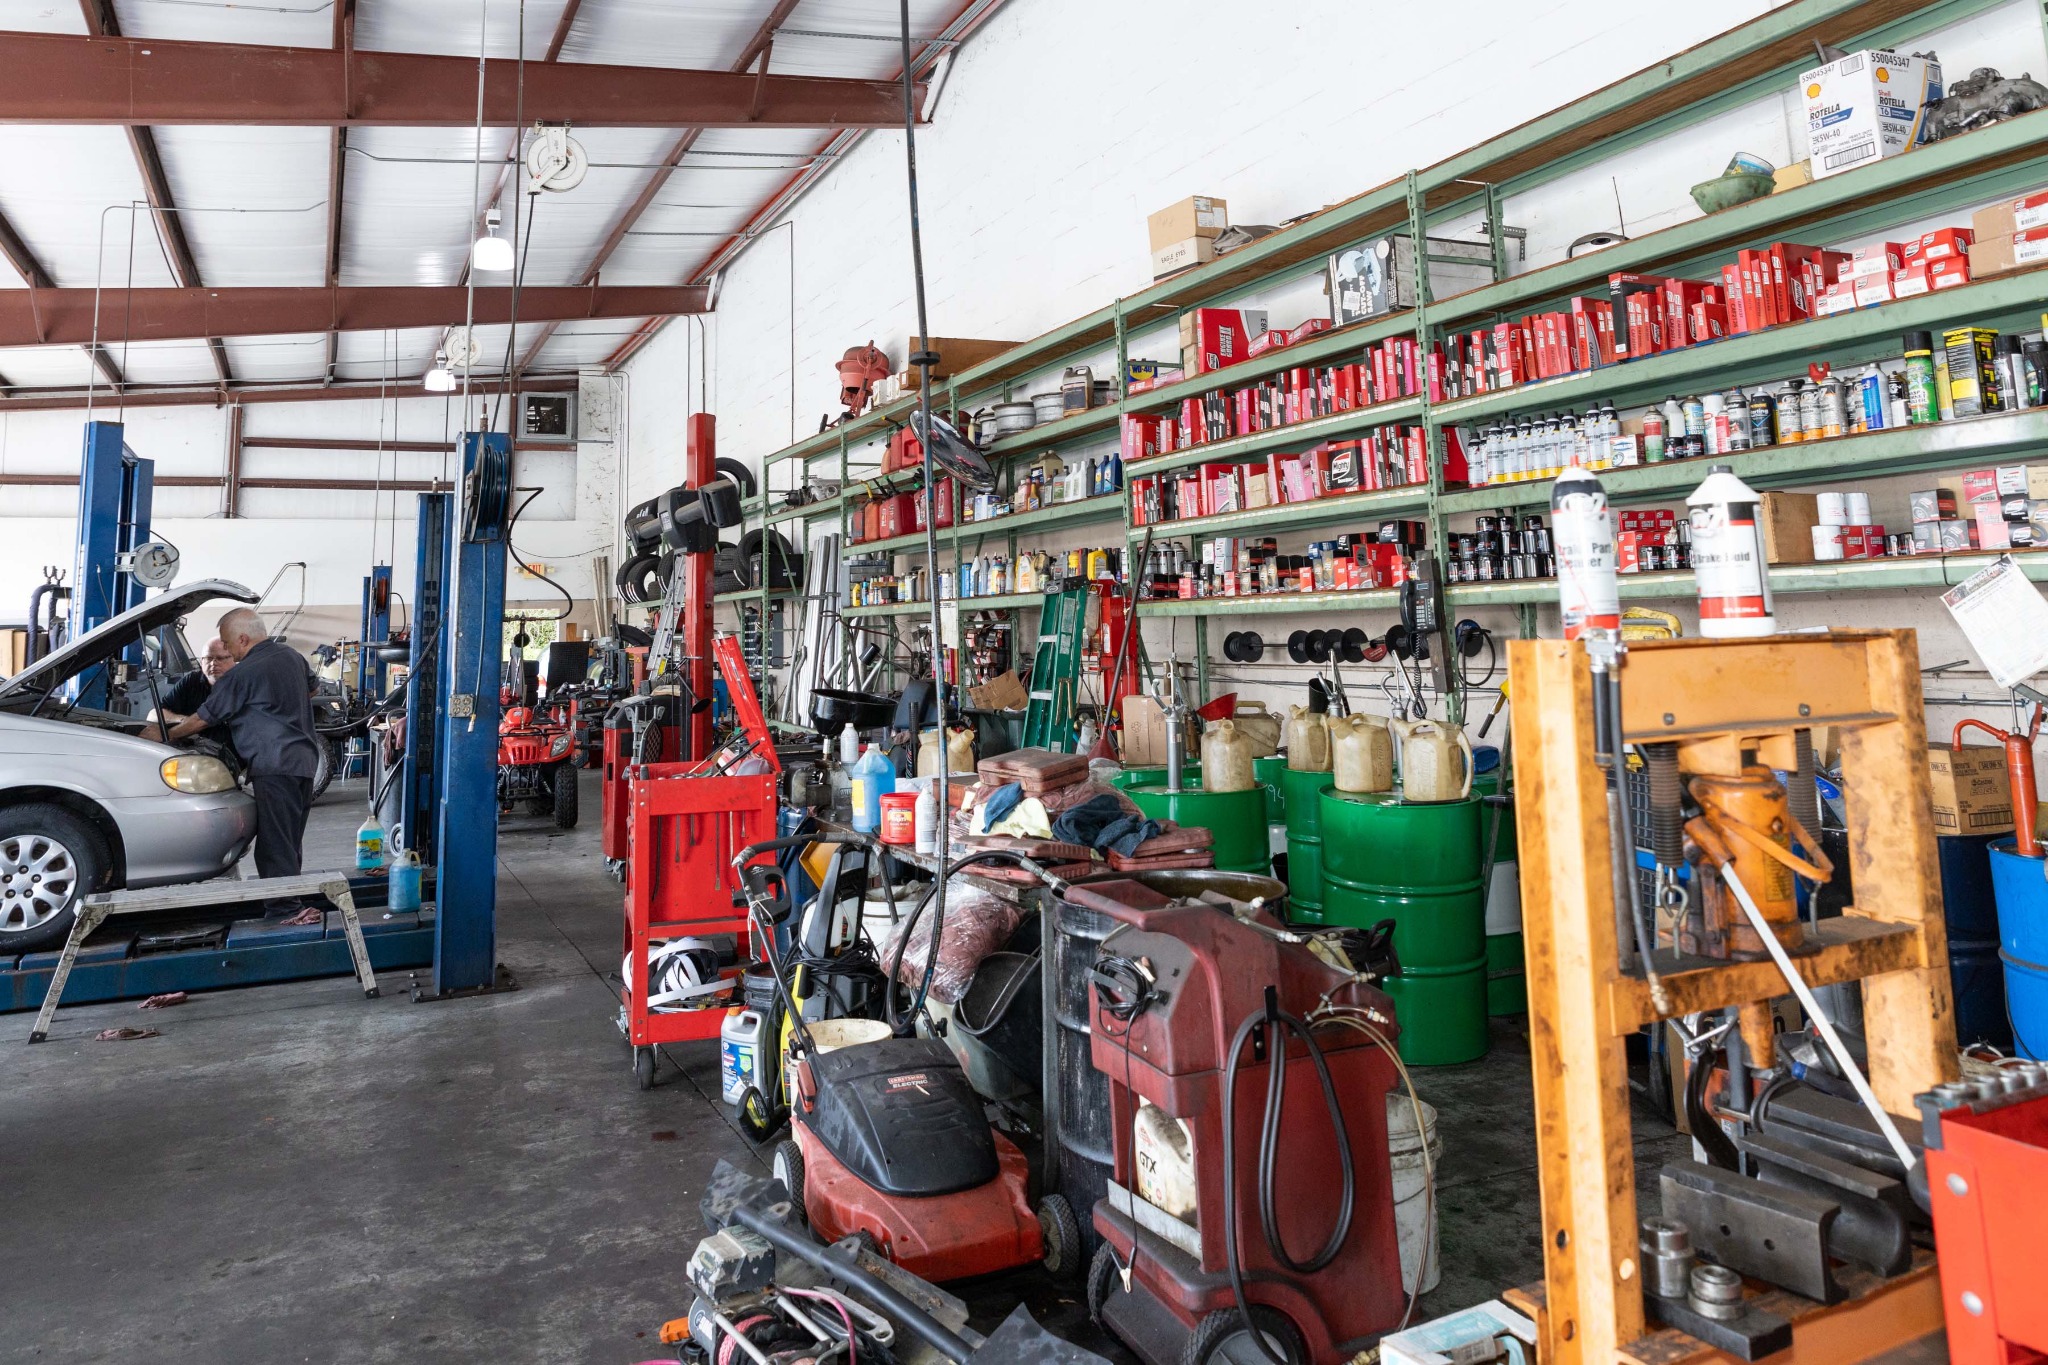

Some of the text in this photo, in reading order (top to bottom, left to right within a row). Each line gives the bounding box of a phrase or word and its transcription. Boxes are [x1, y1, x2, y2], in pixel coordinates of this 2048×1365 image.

[1871, 53, 1911, 69] 550045347
[1801, 64, 1835, 83] 550045347
[1880, 97, 1906, 108] ROTELLA
[1810, 103, 1841, 121] ROTELLA
[1880, 106, 1890, 116] T6
[1810, 121, 1822, 130] T6
[1161, 253, 1174, 264] EAGLE
[1366, 291, 1374, 313] SAW
[1225, 334, 1233, 358] GUARD
[1132, 365, 1153, 374] WD-40
[1333, 461, 1349, 473] Mighty
[1696, 552, 1721, 563] Brake
[888, 1074, 927, 1084] CRAFTSMAN
[892, 1079, 929, 1089] ELECTRIC
[1139, 1150, 1157, 1175] GTX
